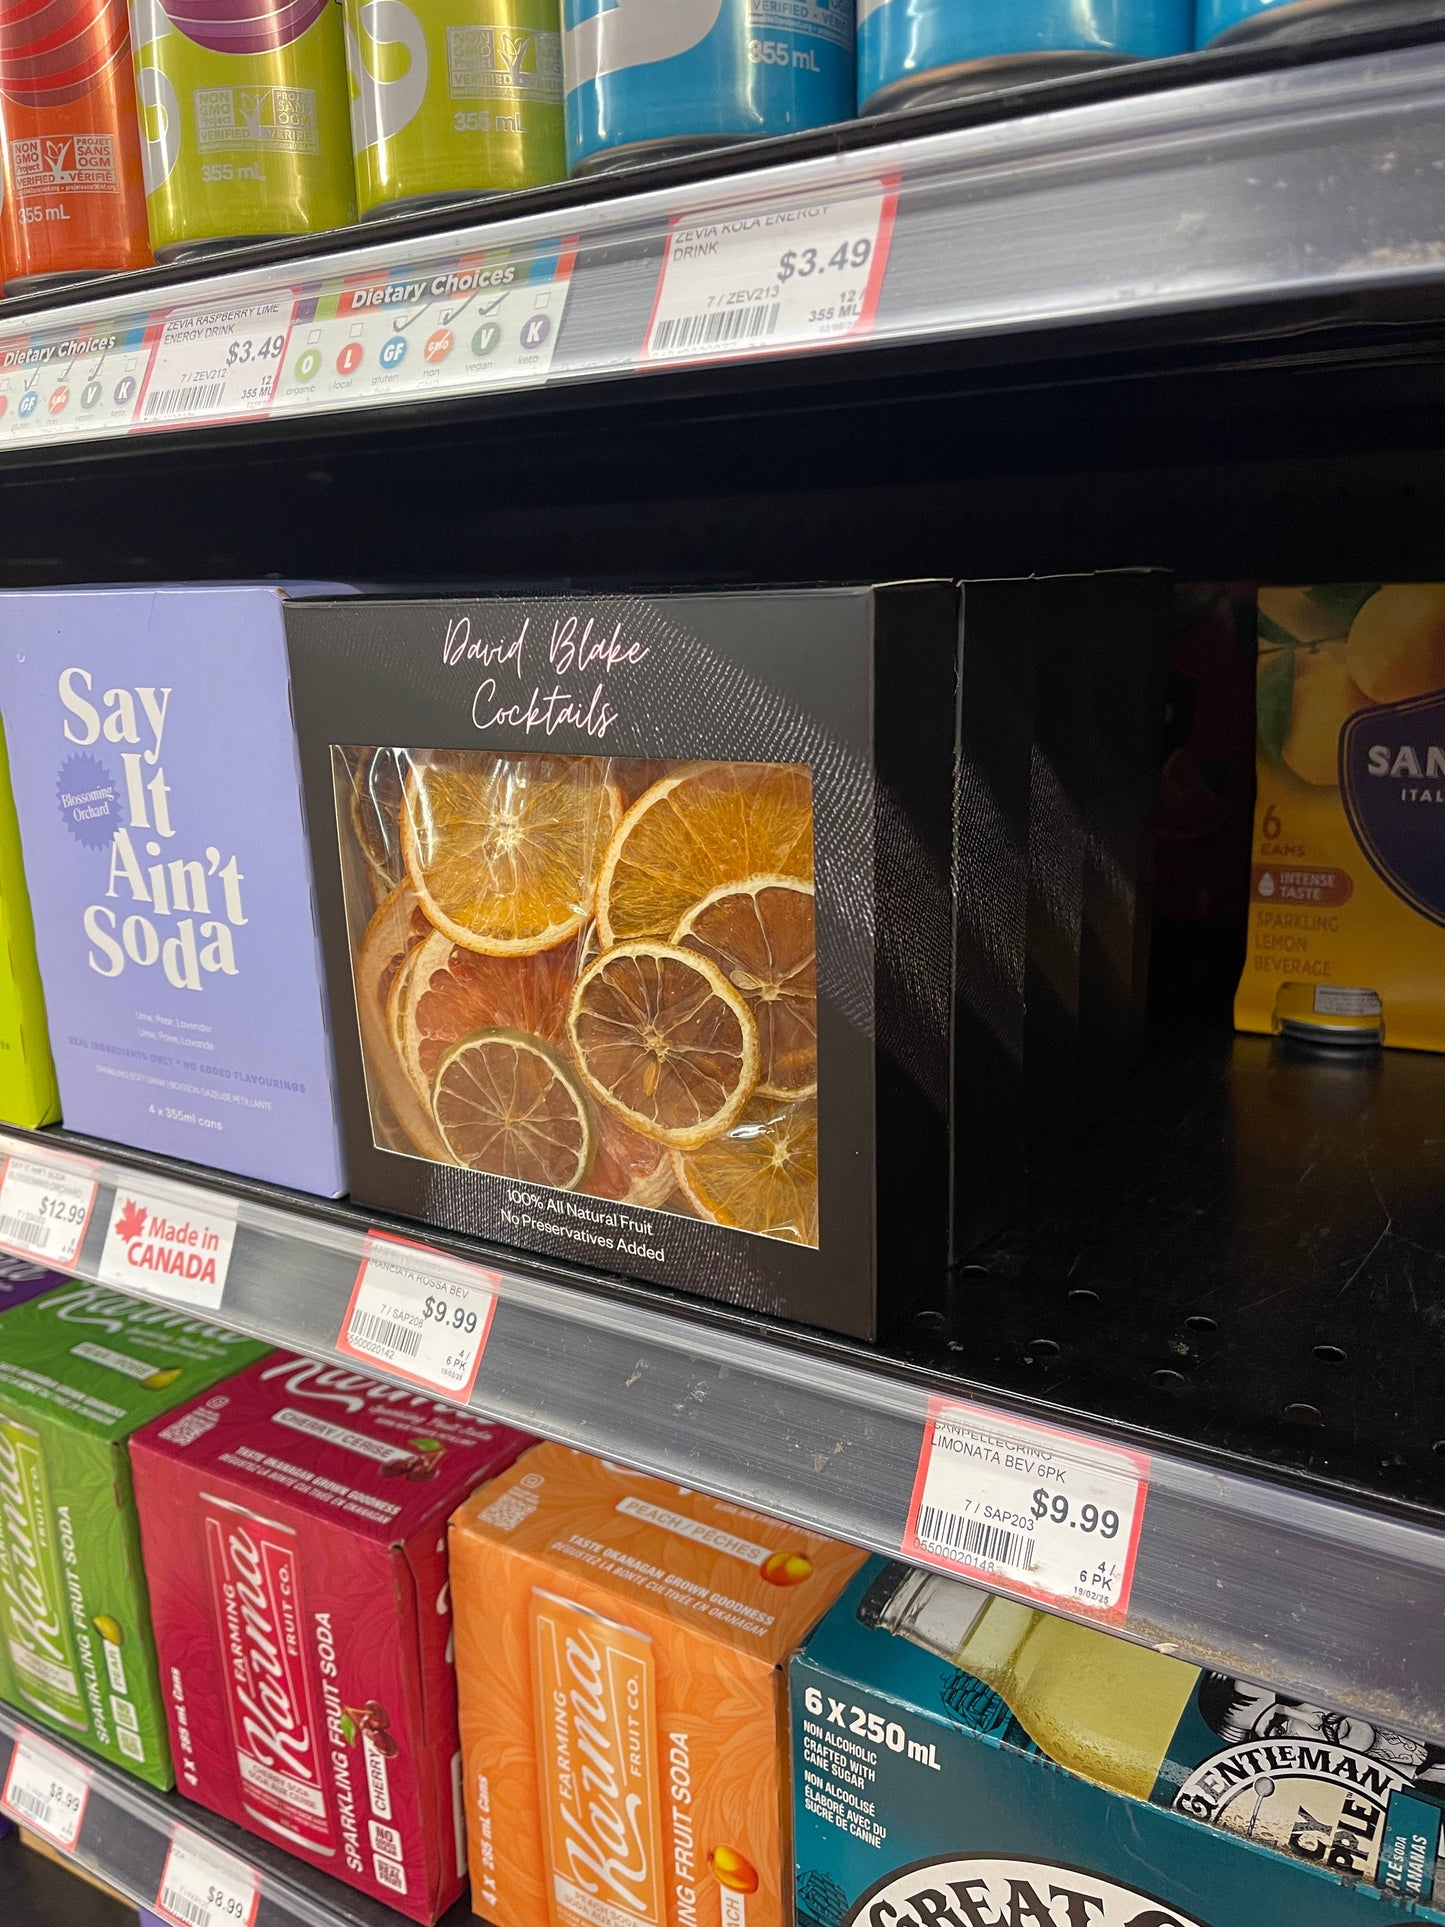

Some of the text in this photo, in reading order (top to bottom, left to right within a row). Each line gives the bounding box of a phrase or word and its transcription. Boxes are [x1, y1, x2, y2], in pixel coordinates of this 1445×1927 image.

[752, 0, 808, 18] VERIFIED
[453, 31, 490, 44] NON
[453, 44, 491, 57] GMO
[748, 40, 820, 72] 355 mL
[453, 73, 512, 86] VERIFIED
[200, 91, 229, 104] NON
[200, 103, 231, 116] GMO
[200, 128, 250, 141] VERIFIED
[453, 111, 527, 133] 355 mL
[15, 141, 38, 154] NON
[76, 138, 110, 146] PROJET
[78, 146, 110, 156] SANS
[15, 152, 39, 165] GMO
[16, 164, 40, 175] Project
[78, 157, 111, 167] OGM
[201, 162, 267, 183] 355 mL
[17, 171, 113, 186] VERIFIED VÉRIFIÉ
[18, 204, 71, 224] 355 mL
[676, 218, 761, 244] ZEVIA KOLA
[673, 241, 719, 262] DRINK
[777, 237, 872, 283] $3.49
[352, 267, 515, 309] Dietary Choices
[725, 284, 780, 305] ZEV213
[840, 289, 856, 304] 12
[167, 303, 279, 331] ZEVIA RASPBERRY LIME
[808, 303, 861, 322] 355 ML
[164, 324, 235, 345] ENERGY DRINK
[527, 322, 543, 342] K
[3, 333, 116, 367] Dietary Choices
[226, 335, 285, 367] $3.49
[383, 343, 403, 362] GF
[193, 368, 227, 382] ZEV212
[241, 388, 257, 399] 355
[443, 617, 649, 678] David Blake
[58, 667, 172, 765] Say
[472, 679, 618, 738] Cocktails
[61, 785, 115, 808] Blossoming
[121, 753, 176, 838] It
[73, 802, 110, 822] Orchard
[1262, 805, 1282, 840] 6
[1260, 843, 1306, 857] CANS
[106, 827, 249, 926] Ain't
[1280, 872, 1336, 888] INTENSE
[1280, 886, 1321, 901] TASTE
[1256, 911, 1339, 932] SPARKLING
[83, 905, 240, 992] Soda
[1255, 934, 1308, 952] LEMON
[1254, 956, 1331, 977] BEVERAGE
[177, 1018, 213, 1034] Lavender
[199, 1063, 231, 1080] ADDED
[234, 1071, 306, 1094] FLAVOURINGS
[198, 1115, 223, 1131] cans
[39, 1196, 85, 1225] $12.99
[507, 1189, 653, 1235] 100% All Natural Fruit
[149, 1216, 219, 1251] Made in
[500, 1209, 665, 1262] No Preservatives Added
[127, 1241, 216, 1284] CANADA
[416, 1274, 469, 1299] ROSSA BEV
[392, 1308, 424, 1329] SAP208
[422, 1296, 478, 1334] $9.99
[453, 1358, 468, 1372] PK
[281, 1411, 393, 1458] CHERRY CERISE
[930, 1433, 1066, 1483] LIMONATA BEV 6PK
[625, 1501, 683, 1528] PEACH
[965, 1500, 1035, 1532] 7 SAP203
[1030, 1488, 1120, 1539] $9.99
[912, 1537, 995, 1573] 05500020148
[1098, 1561, 1107, 1573] 4
[569, 1535, 775, 1626] TASTE OKANAGAN GROWN GOODNESS
[1073, 1586, 1110, 1605] 19/02/25
[1079, 1570, 1113, 1591] 6 PK
[280, 1564, 298, 1656] FRUIT CO.
[691, 1601, 768, 1637] EN OKANAGAN
[57, 1506, 110, 1745] SPARKLING FRUIT SODA
[224, 1583, 245, 1682] FARMING
[229, 1527, 313, 1778] Karma
[171, 1667, 184, 1702] Cans
[629, 1675, 642, 1778] FRUIT CO.
[805, 1687, 941, 1771] 6 X 250 mL
[315, 1612, 363, 1873] SPARKLING FRUIT SODA
[553, 1691, 573, 1800] FARMING
[803, 1720, 877, 1766] NON ALCOHOLIC
[560, 1628, 648, 1912] Karma
[803, 1736, 876, 1782] CRAFTED WITH
[804, 1749, 865, 1790] CANE SUGAR
[368, 1749, 387, 1811] CHERRY
[477, 1775, 490, 1813] Cans
[804, 1770, 876, 1817] NON ALCOOLISÉ
[1176, 1745, 1395, 1822] GENTLEMAN
[49, 1782, 80, 1812] $8.99
[669, 1732, 695, 1882] FRUIT SODA
[804, 1784, 887, 1839] ÉLABORÉ AVEC DU
[805, 1798, 881, 1849] SUCRE DE CANNE
[207, 1886, 243, 1919] $8.99
